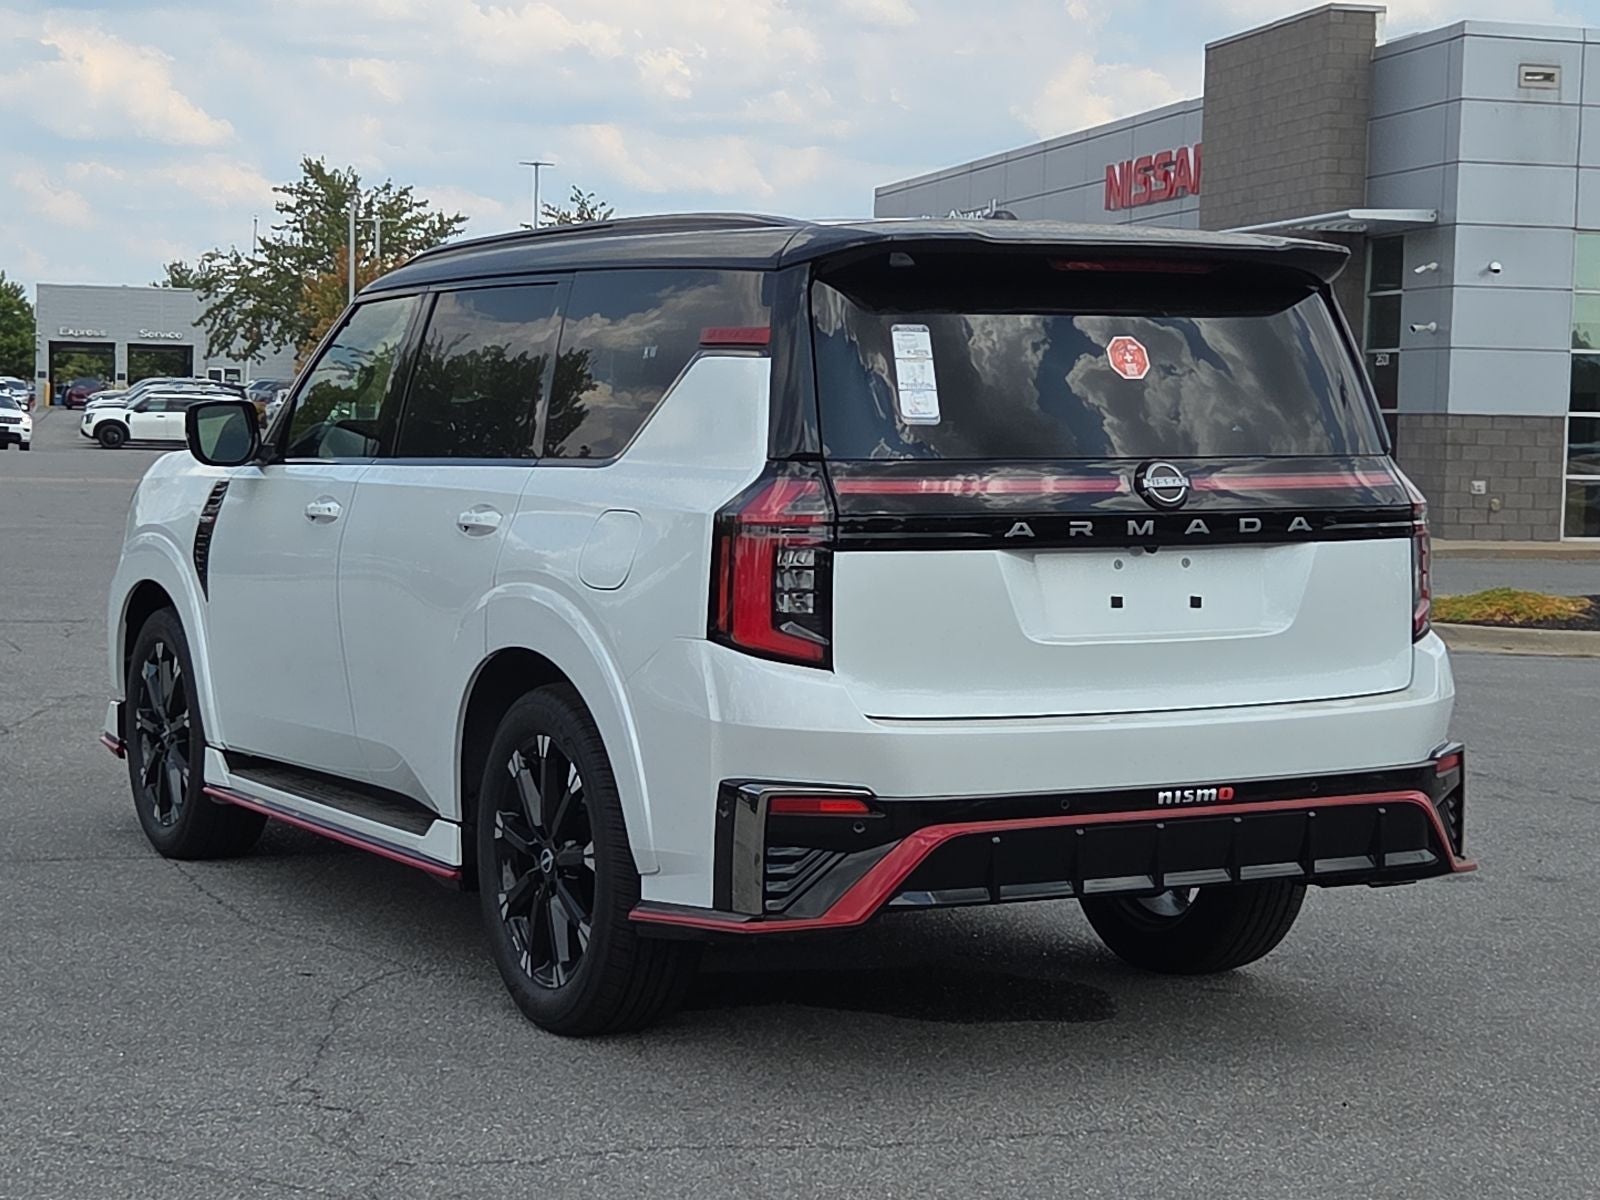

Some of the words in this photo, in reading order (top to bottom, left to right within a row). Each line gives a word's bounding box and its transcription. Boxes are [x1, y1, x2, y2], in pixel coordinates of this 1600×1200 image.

[58, 327, 107, 337] Express
[139, 329, 184, 339] Service
[1004, 516, 1313, 538] ARMADA
[1158, 787, 1234, 805] nismo
